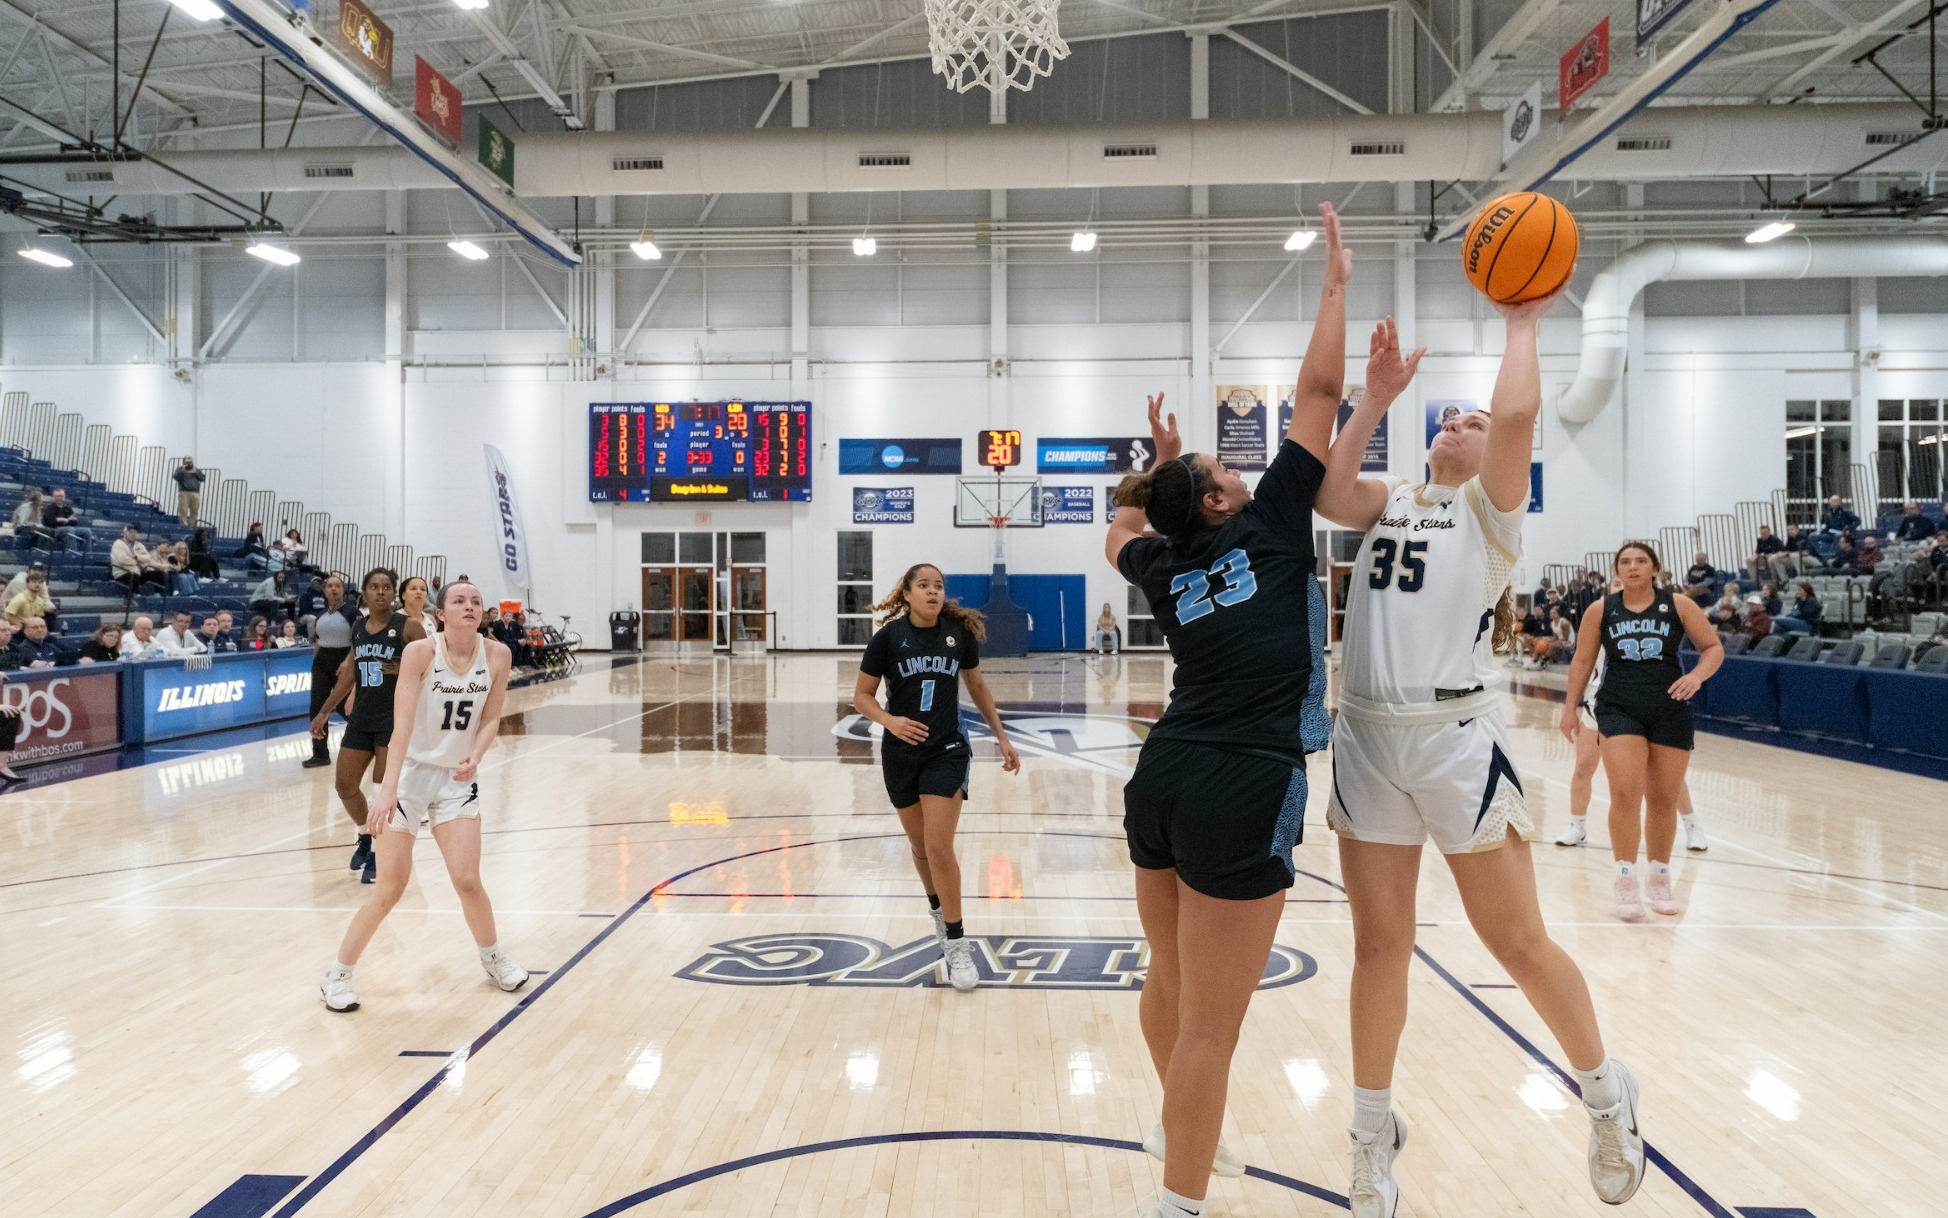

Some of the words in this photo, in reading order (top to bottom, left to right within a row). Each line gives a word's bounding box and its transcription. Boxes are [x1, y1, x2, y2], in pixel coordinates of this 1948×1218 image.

[1468, 206, 1515, 274] Wilson
[593, 405, 610, 413] player
[630, 405, 646, 413] fouls
[753, 404, 771, 412] player
[771, 404, 789, 412] points
[790, 404, 806, 412] fouls
[619, 413, 628, 427] 8
[637, 413, 645, 427] 0
[655, 413, 675, 431] 34
[727, 413, 748, 430] 28
[779, 412, 788, 426] 9
[798, 412, 806, 426] 0
[619, 427, 628, 439] 3
[637, 427, 645, 439] 0
[689, 430, 710, 438] period
[715, 425, 723, 439] 3
[779, 426, 788, 438] 0
[989, 431, 1020, 446] 7:17
[619, 440, 628, 452] 0
[637, 440, 645, 452] 2
[653, 441, 668, 449] fouls
[779, 439, 788, 451] 7
[798, 439, 806, 451] 0
[619, 451, 628, 464] 0
[637, 451, 645, 464] 0
[658, 451, 667, 464] 2
[735, 450, 745, 464] 0
[779, 450, 788, 463] 7
[798, 450, 806, 463] 2
[987, 444, 1012, 465] 20
[1044, 450, 1106, 462] CHAMPIONS
[619, 464, 628, 477] 4
[691, 466, 708, 474] game
[779, 463, 788, 476] 2
[798, 463, 806, 476] 0
[619, 489, 627, 501] 4
[885, 489, 913, 498] 2023
[1064, 489, 1092, 497] 2022
[855, 513, 913, 521] CHAMPIONS
[504, 542, 518, 572] GO
[1367, 536, 1430, 593] 35
[1169, 548, 1258, 626] 23
[1608, 618, 1670, 639] LINCOLN
[1616, 637, 1663, 662] 32
[898, 655, 960, 678] LINCOLN
[358, 661, 384, 687] 15
[266, 672, 312, 697] SPRIN
[432, 681, 465, 694] Prairie
[157, 680, 246, 712] ILLINOIS
[919, 679, 936, 711] 1
[440, 700, 474, 731] 15
[7, 740, 84, 763] nkwithbos.com
